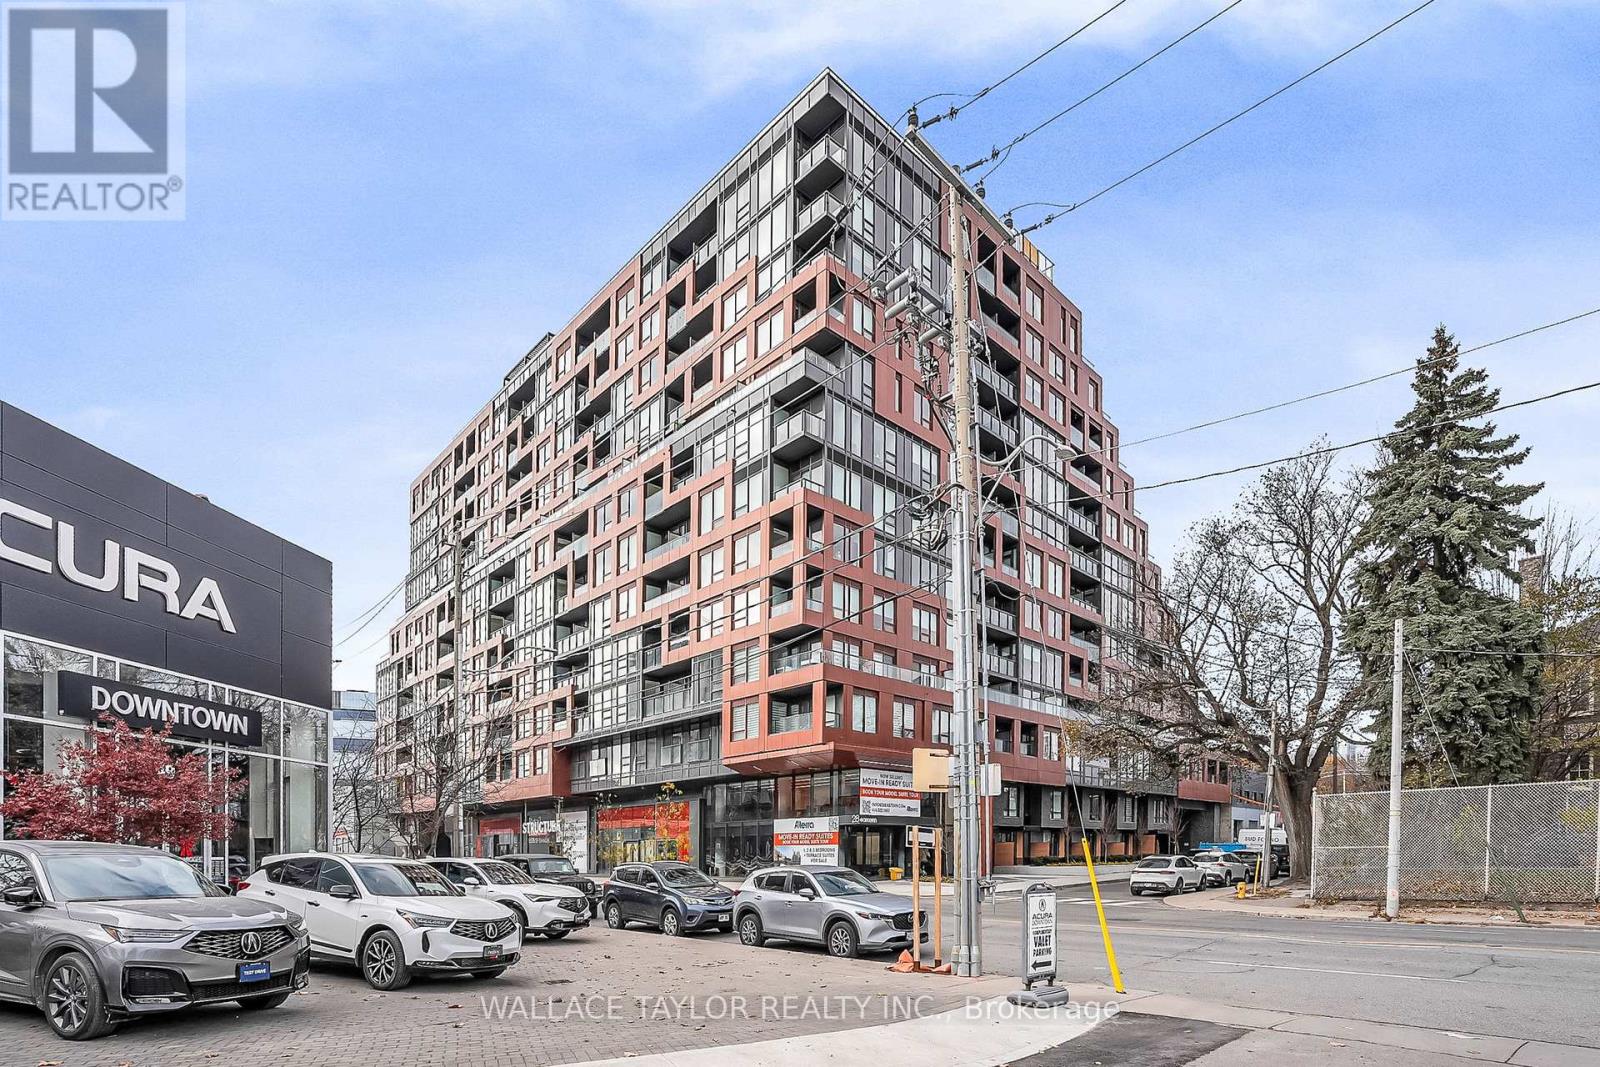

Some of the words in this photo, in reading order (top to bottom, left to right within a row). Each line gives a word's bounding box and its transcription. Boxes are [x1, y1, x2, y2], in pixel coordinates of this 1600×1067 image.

[0, 500, 236, 633] CURA
[91, 685, 249, 736] DOWNTOWN
[862, 778, 884, 786] MOVE-IN
[1034, 935, 1051, 948] VALET
[1033, 948, 1052, 957] PARKING
